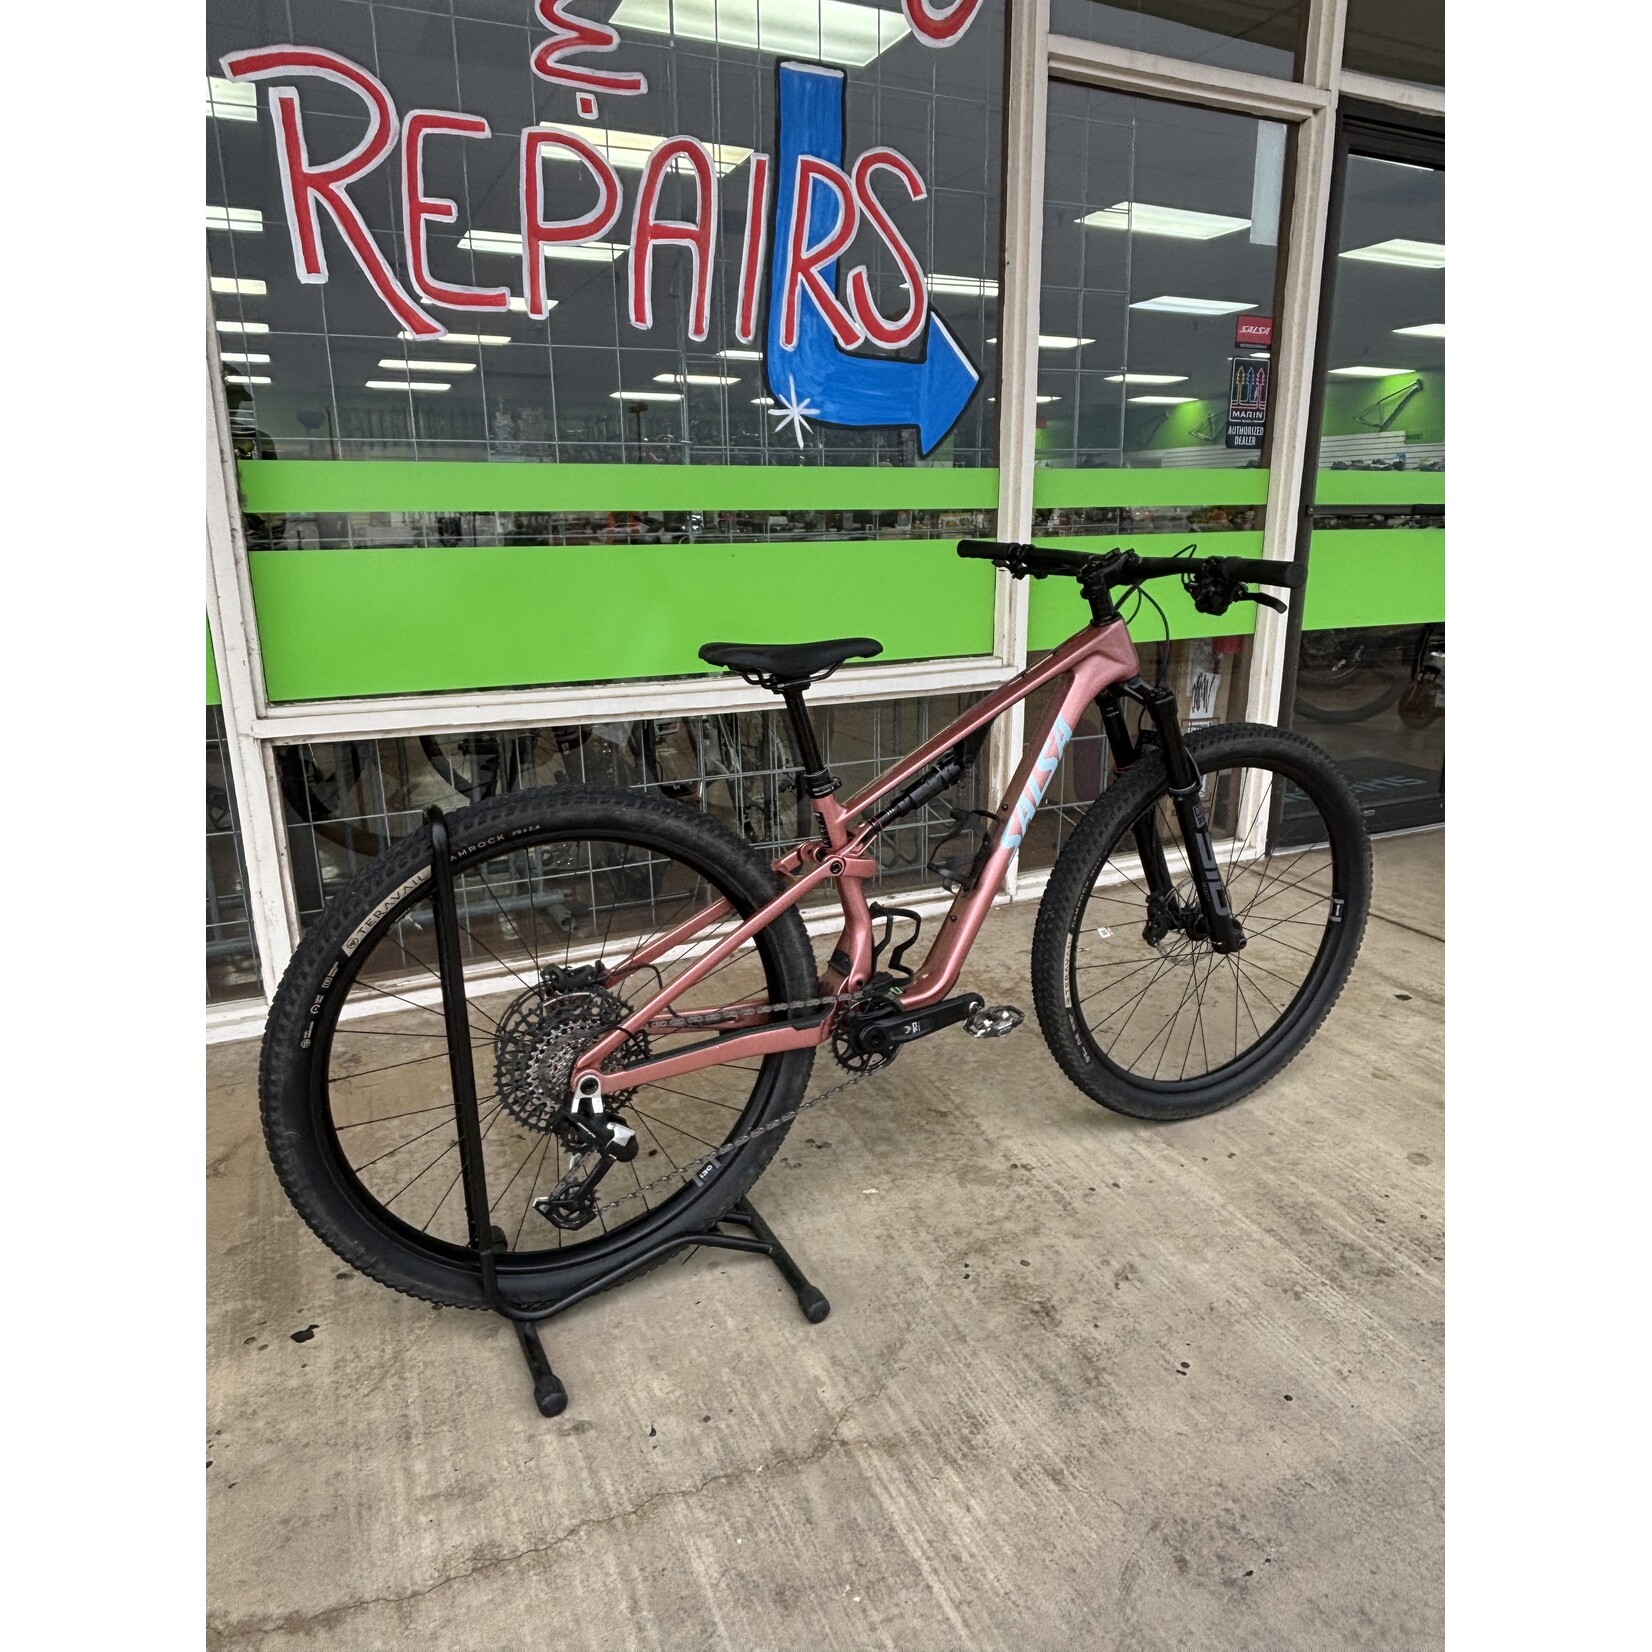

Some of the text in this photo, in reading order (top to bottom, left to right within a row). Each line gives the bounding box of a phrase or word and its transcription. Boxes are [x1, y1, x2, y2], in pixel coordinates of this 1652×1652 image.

[219, 43, 928, 351] REPAIRS
[1239, 325, 1271, 335] SALSA
[1232, 410, 1263, 419] MARIN
[1228, 425, 1264, 436] AUTHORIZED
[1234, 436, 1257, 446] DEALER
[1001, 715, 1073, 866] SALSA
[356, 875, 428, 936] TERAVAIL
[450, 834, 505, 862] AMROCK
